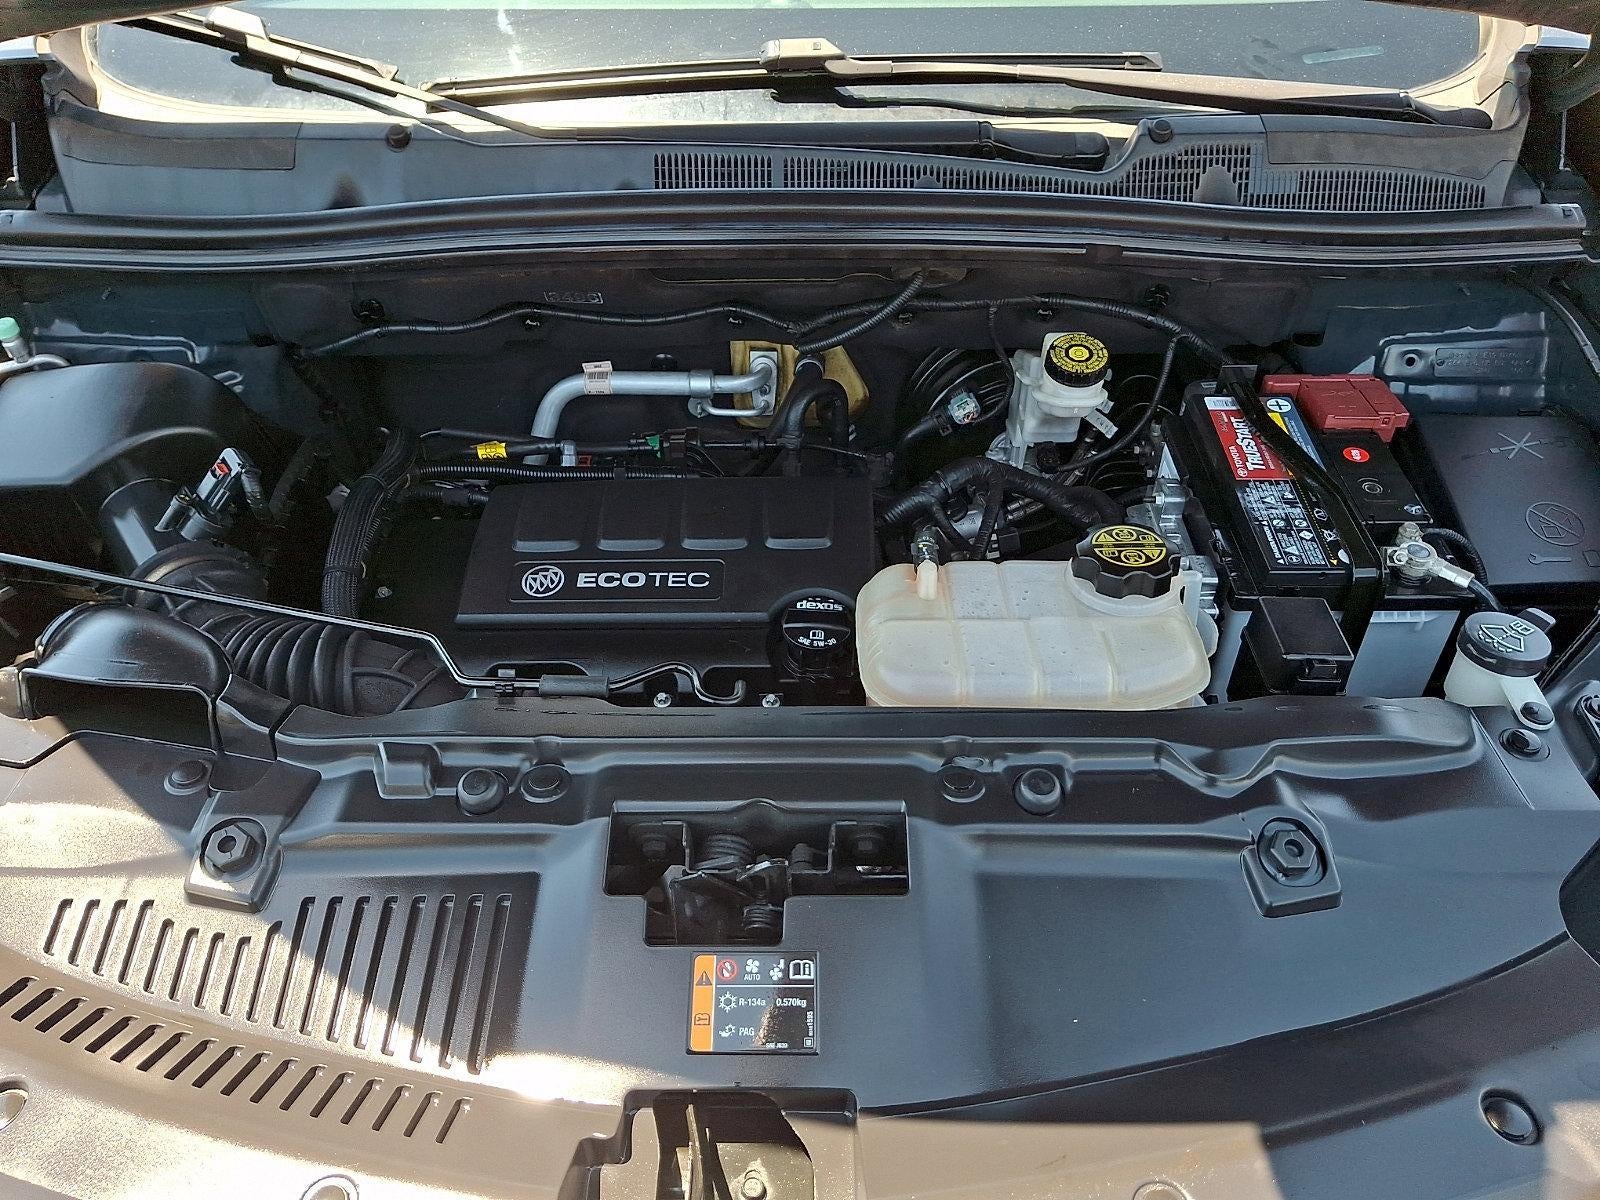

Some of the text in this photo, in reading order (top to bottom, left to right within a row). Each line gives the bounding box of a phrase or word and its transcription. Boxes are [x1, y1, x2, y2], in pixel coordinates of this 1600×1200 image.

[1229, 445, 1245, 469] TOYOTA
[576, 572, 710, 588] ECOTEC
[796, 600, 843, 611] dexos
[797, 636, 812, 646] SAE
[743, 973, 761, 981] AUTO
[738, 998, 807, 1008] R-134a 0.570kg
[738, 1027, 755, 1036] PAG
